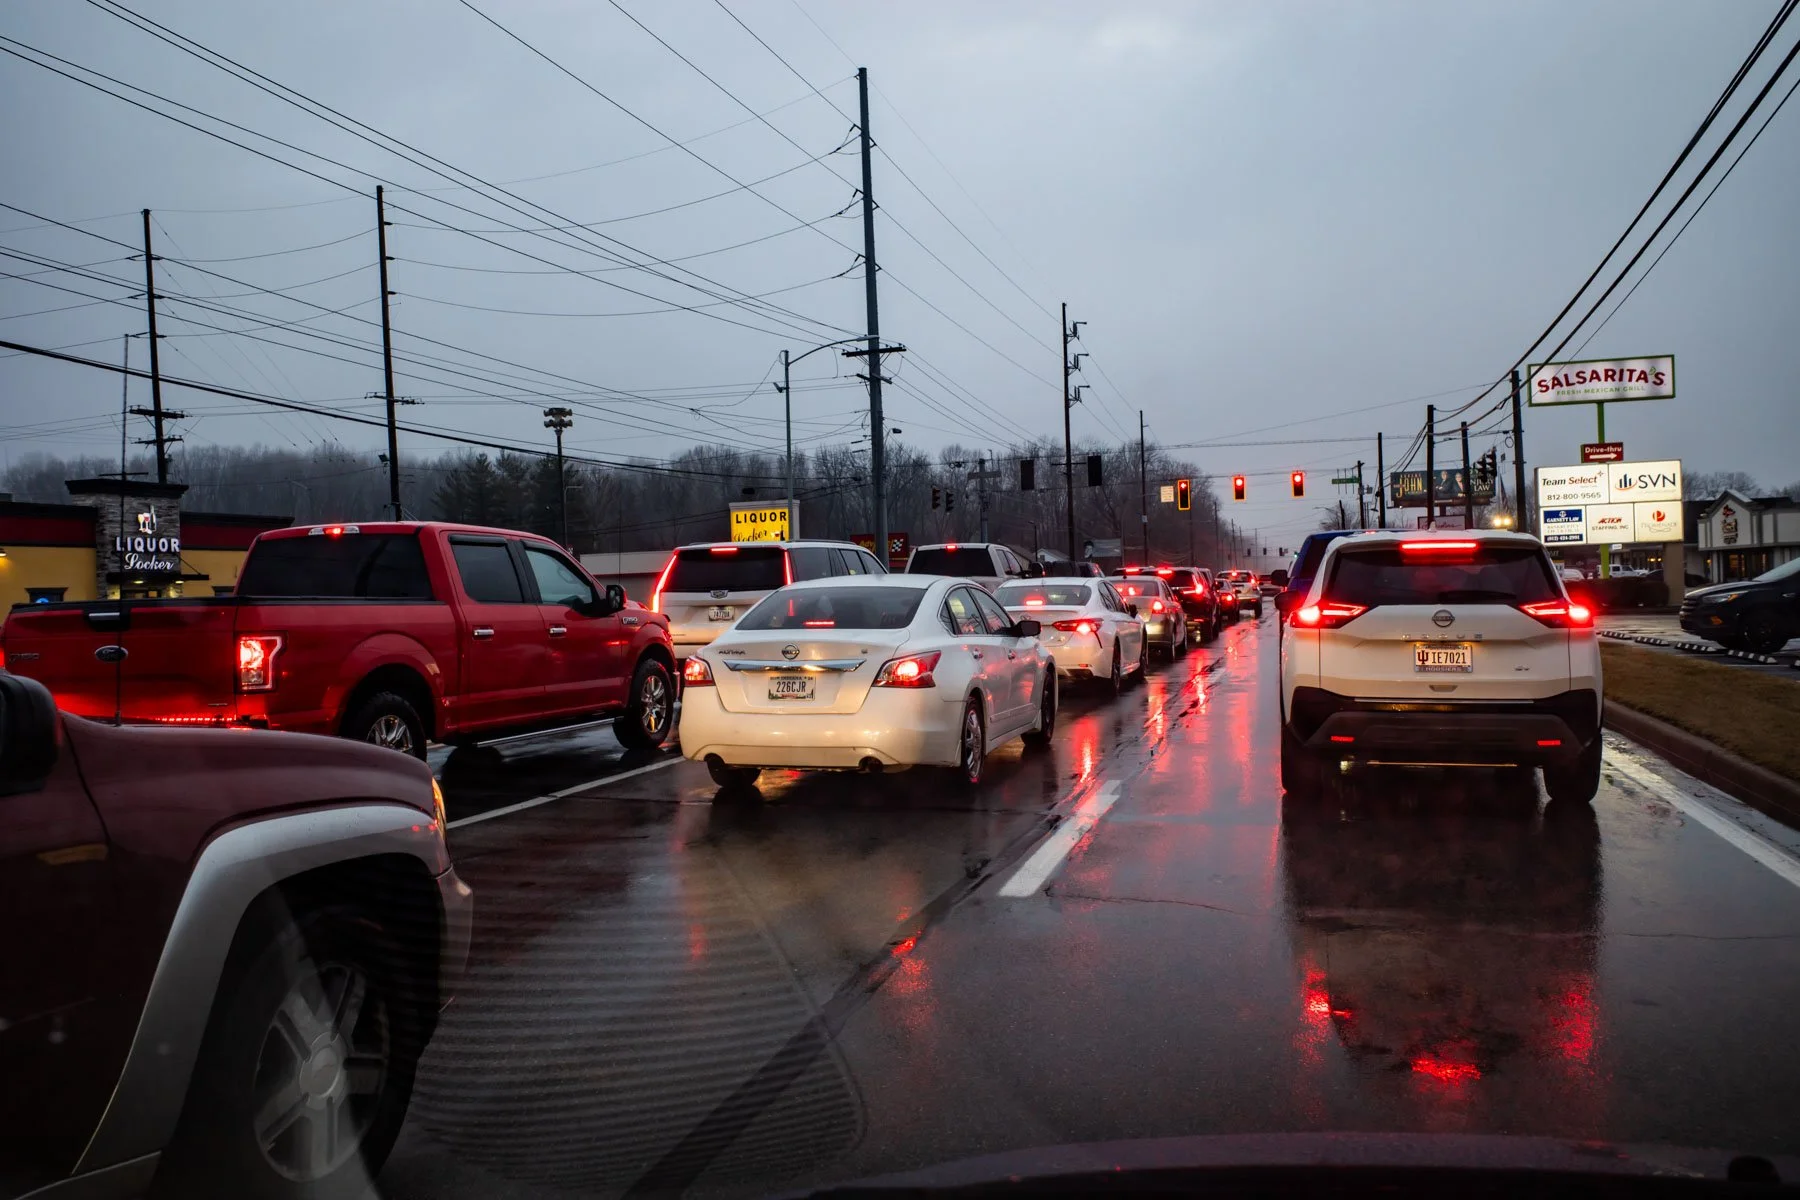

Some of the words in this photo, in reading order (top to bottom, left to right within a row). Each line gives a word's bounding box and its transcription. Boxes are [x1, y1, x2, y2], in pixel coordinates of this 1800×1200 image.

[1537, 366, 1667, 394] SALSARITA'S
[1584, 386, 1620, 395] MEXICAN
[1622, 385, 1646, 393] GRILL
[1542, 478, 1567, 486] Team
[1568, 475, 1598, 485] Select
[1638, 472, 1677, 490] SVN
[1547, 492, 1602, 501] 812-800-9565
[736, 511, 787, 524] LIQUOR
[116, 536, 180, 552] LIQUOR
[124, 552, 174, 570] Locker
[1431, 651, 1467, 664] IE7021
[776, 680, 807, 693] 226CJR
